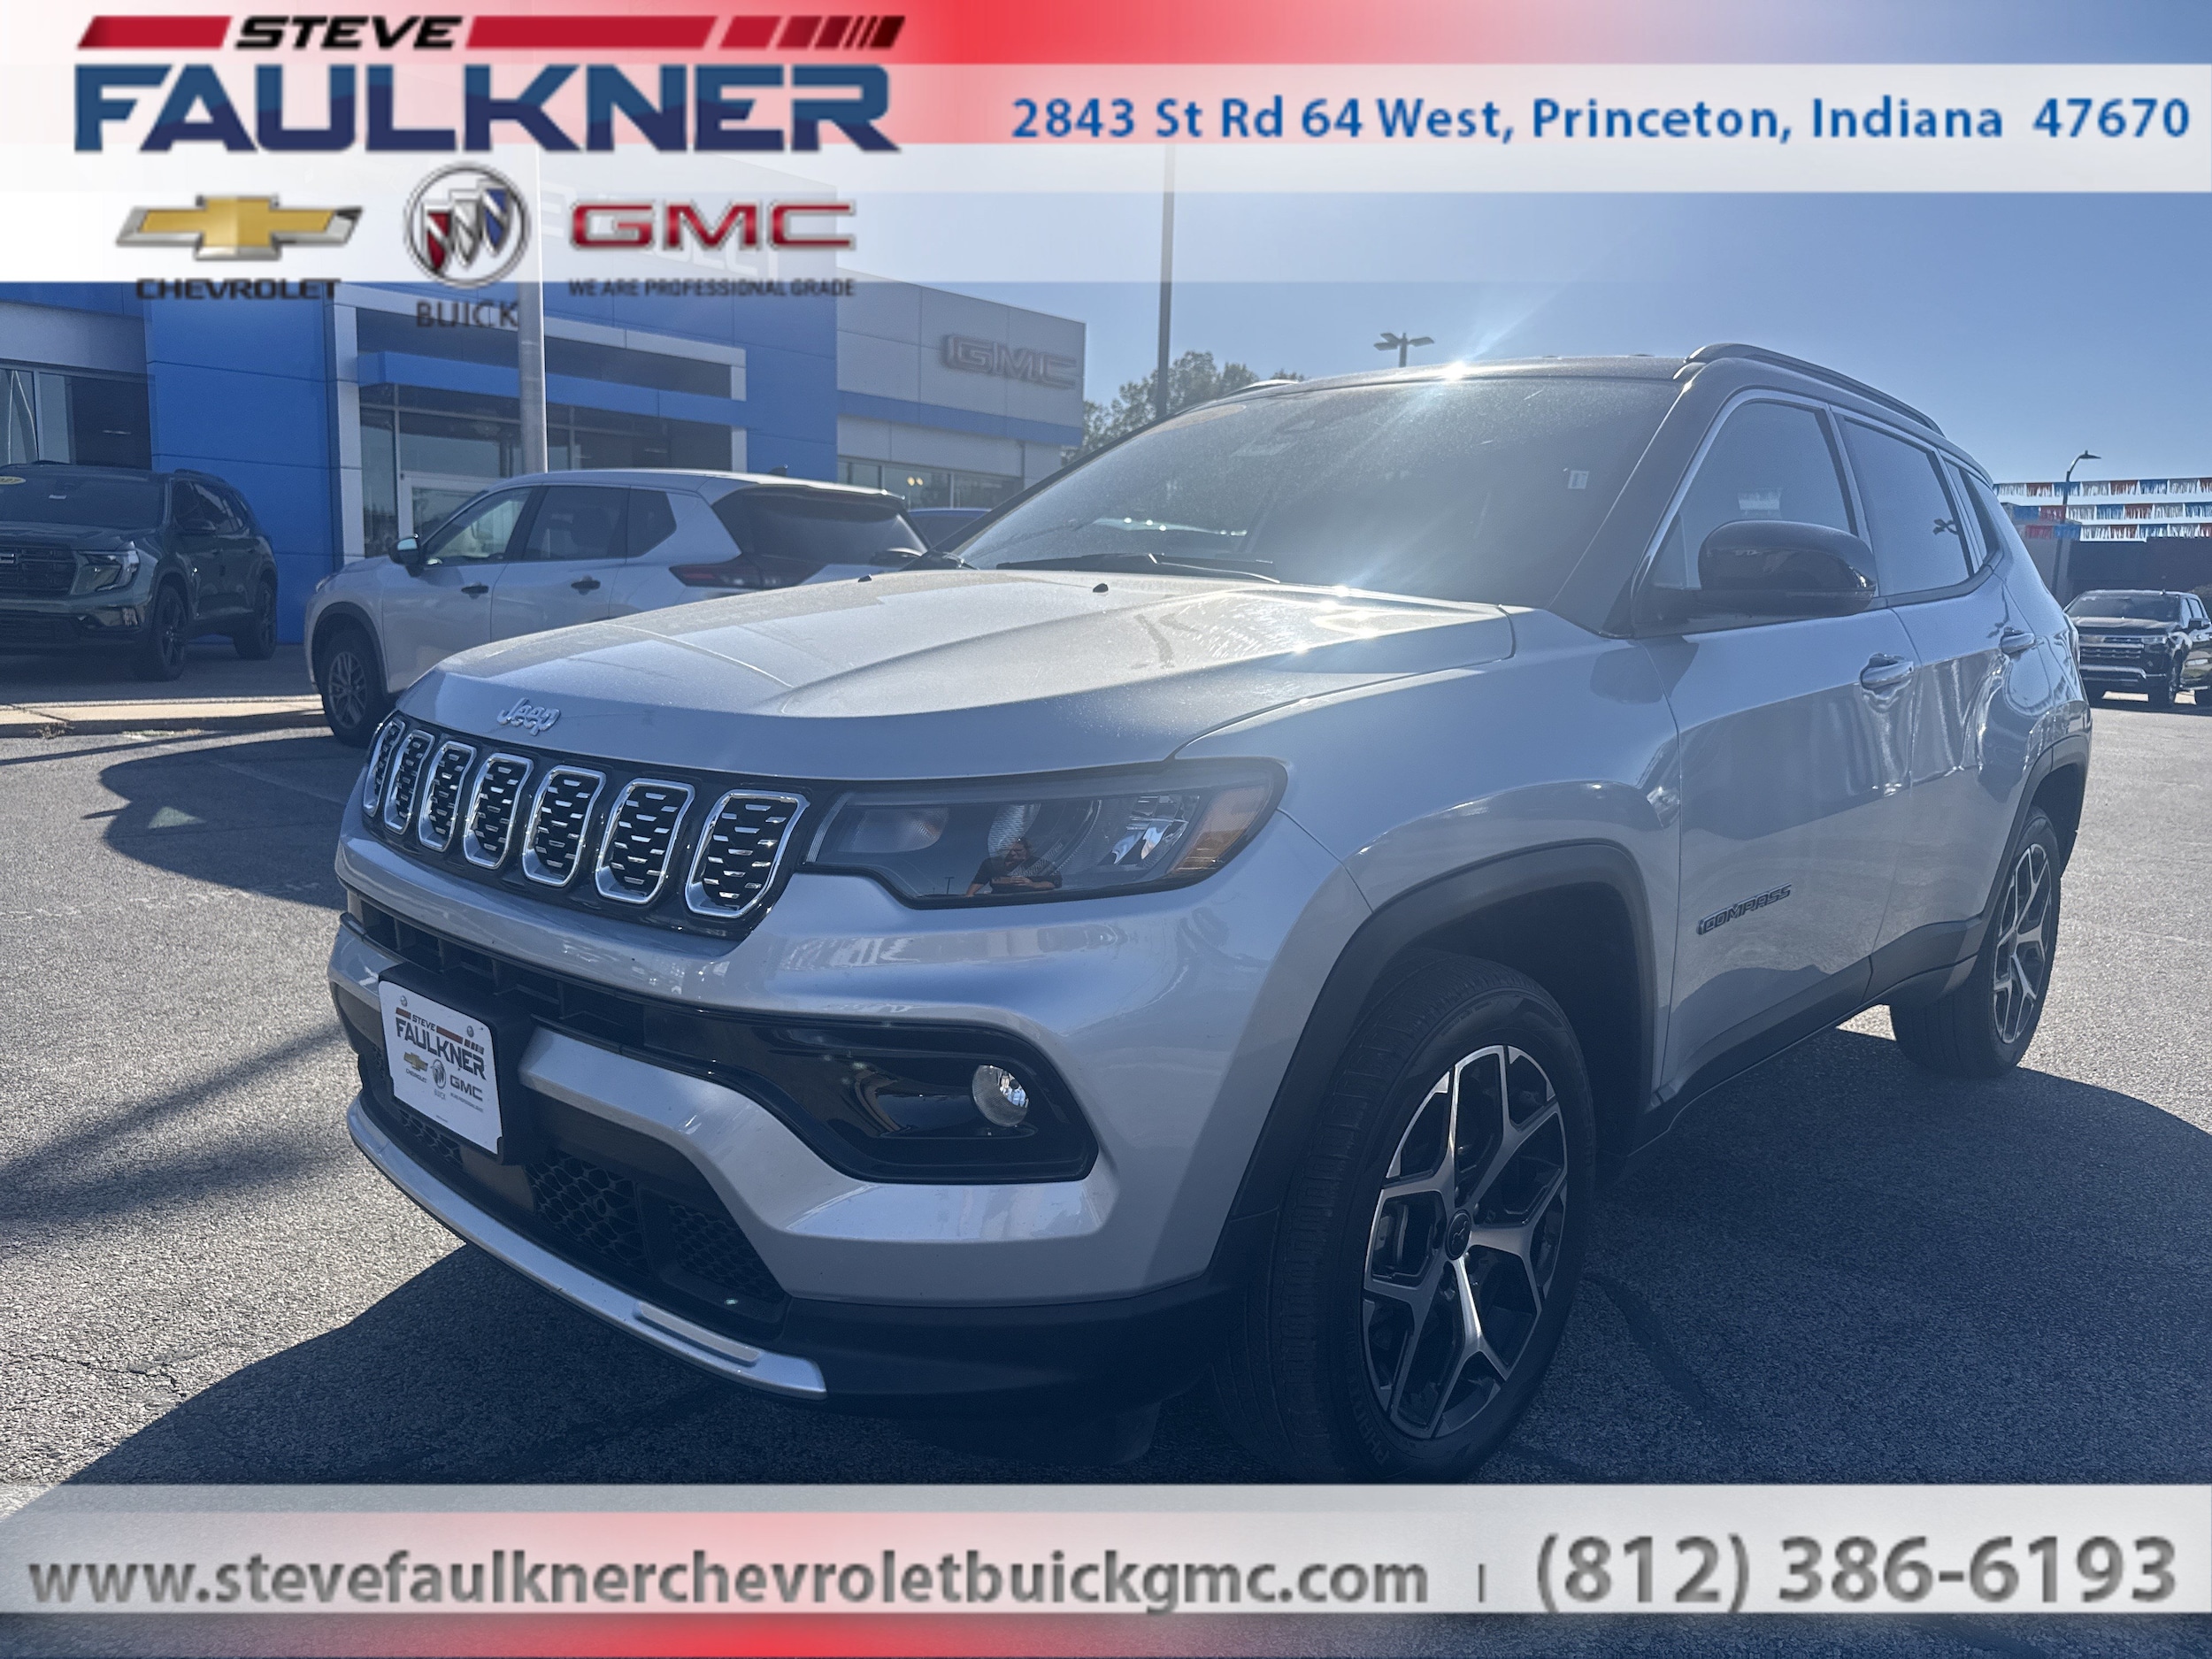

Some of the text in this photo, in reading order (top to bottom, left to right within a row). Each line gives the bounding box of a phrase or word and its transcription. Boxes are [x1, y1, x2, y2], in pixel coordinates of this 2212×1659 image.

[941, 334, 1077, 390] GMC
[496, 697, 561, 736] Jeep
[1696, 883, 1792, 935] COMPASS
[411, 1014, 435, 1032] STEVE
[396, 1017, 487, 1080] FAULKNER
[449, 1074, 483, 1102] GMC
